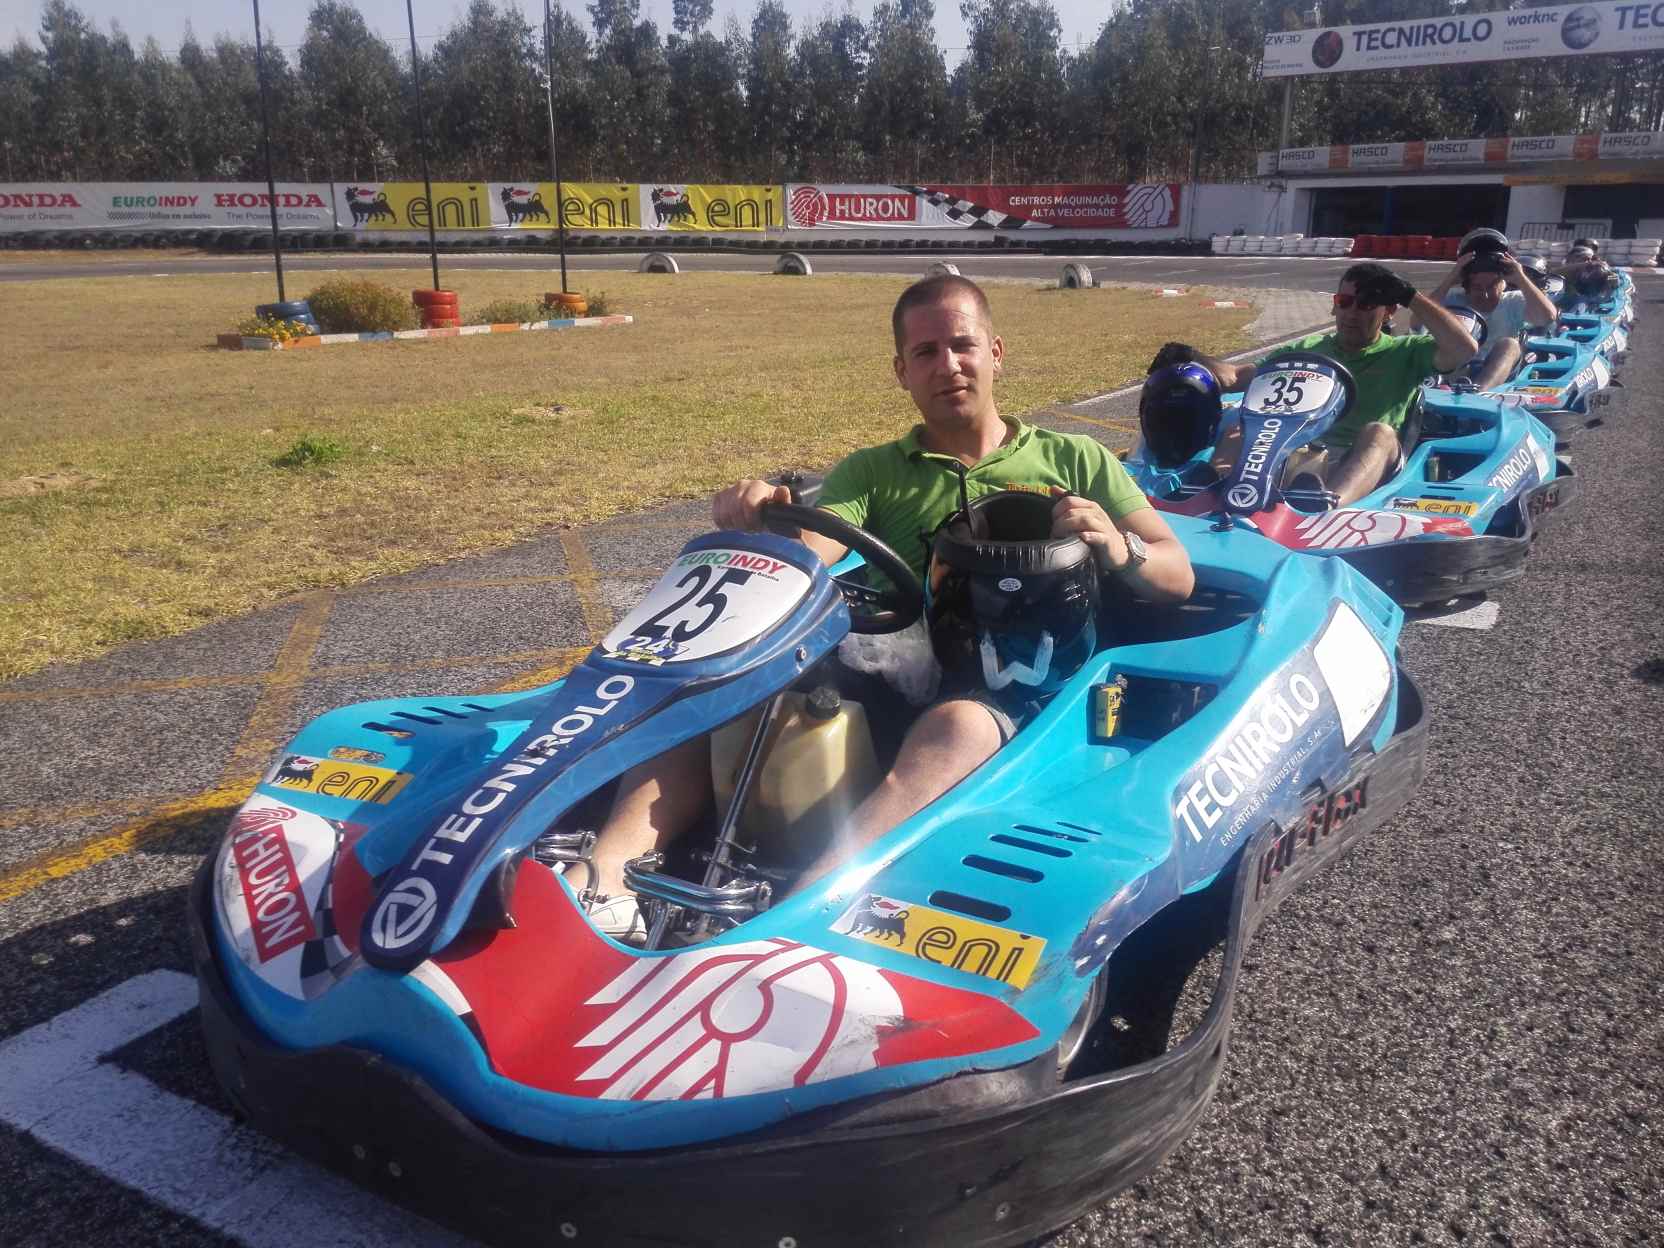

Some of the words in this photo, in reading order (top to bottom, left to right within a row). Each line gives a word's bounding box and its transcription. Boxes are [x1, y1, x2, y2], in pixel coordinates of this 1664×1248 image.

[1352, 18, 1493, 51] TECNIROLO
[1506, 11, 1559, 26] worknc
[1511, 139, 1555, 150] HASCO
[112, 195, 198, 208] EUROINDY
[213, 193, 327, 208] HONDA
[407, 186, 480, 228] eni
[562, 186, 630, 228] eni
[706, 187, 773, 228] eni
[835, 197, 910, 219] HURON
[1009, 196, 1053, 205] CENTROS
[1054, 194, 1118, 206] MAQUINAÇÃO
[1032, 208, 1056, 217] ALTA
[1057, 208, 1116, 217] VELOCIDADE
[1263, 376, 1307, 407] 35
[1240, 418, 1282, 481] TECNIROLO
[678, 553, 788, 574] EUROINDY
[629, 564, 756, 643] 25
[412, 674, 634, 870] TECNIROLO
[1175, 673, 1320, 842] TECNIROLO
[318, 770, 402, 803] eni
[241, 826, 306, 949] HURON
[915, 926, 1031, 982] eni
